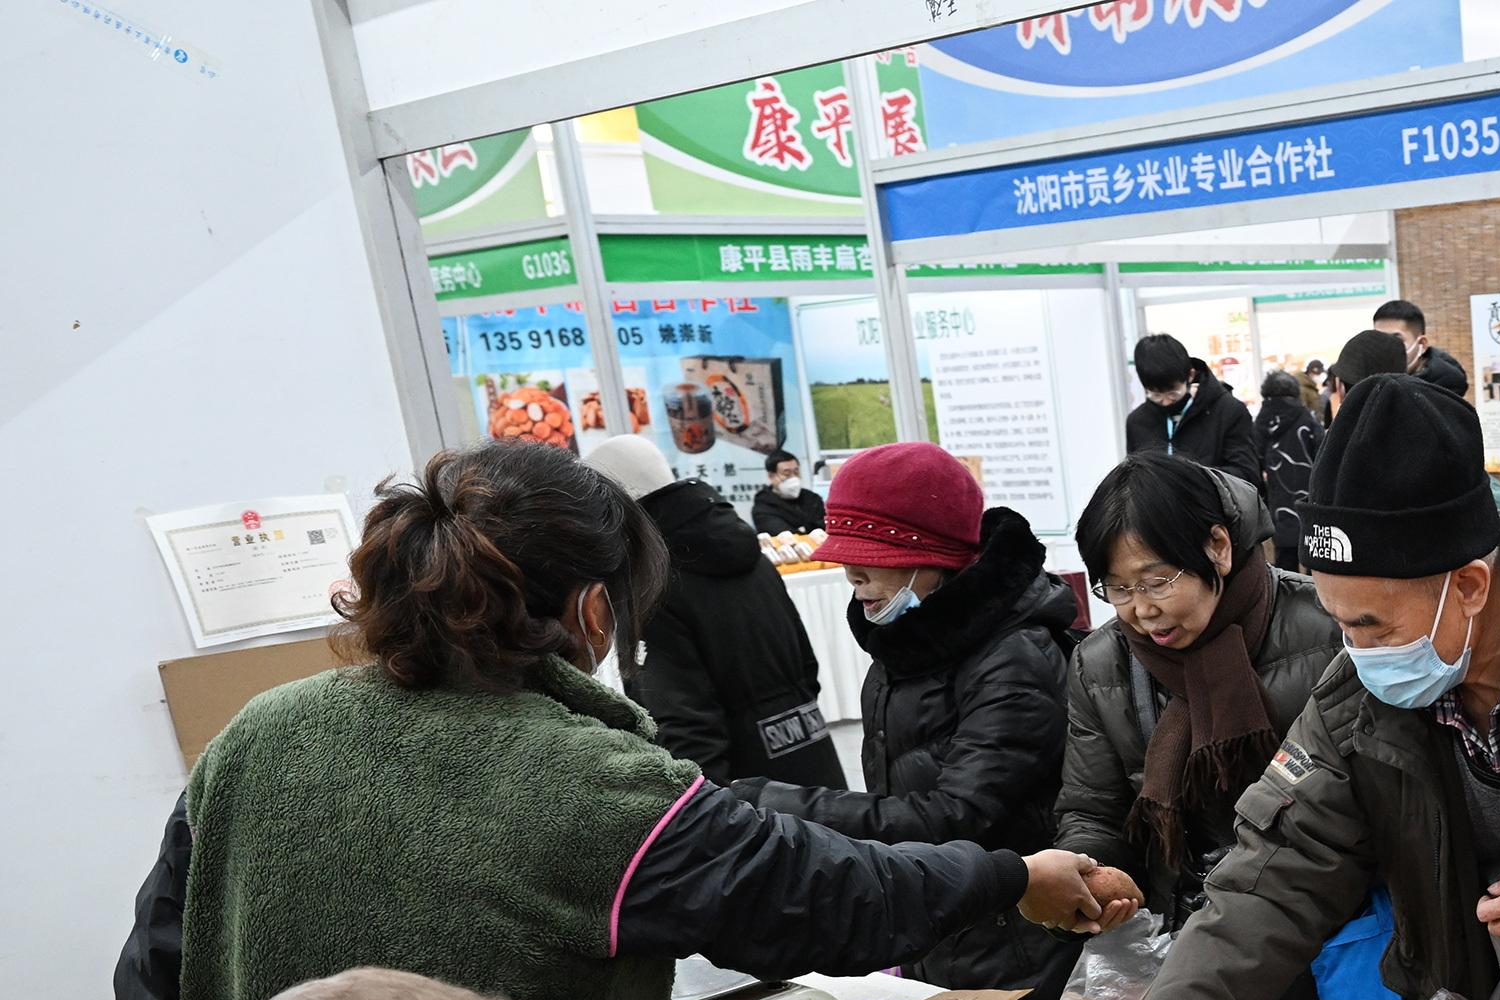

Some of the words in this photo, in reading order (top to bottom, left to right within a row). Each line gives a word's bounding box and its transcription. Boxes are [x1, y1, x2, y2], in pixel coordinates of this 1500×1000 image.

[1013, 136, 1335, 215] 沈阳市贡乡米业专业合作社
[1400, 115, 1500, 165] F1035
[479, 329, 523, 352] 135
[528, 327, 586, 350] 9168
[618, 326, 644, 347] 05
[1312, 523, 1331, 538] THE
[1303, 535, 1332, 549] NORTH
[1308, 546, 1331, 559] FACE
